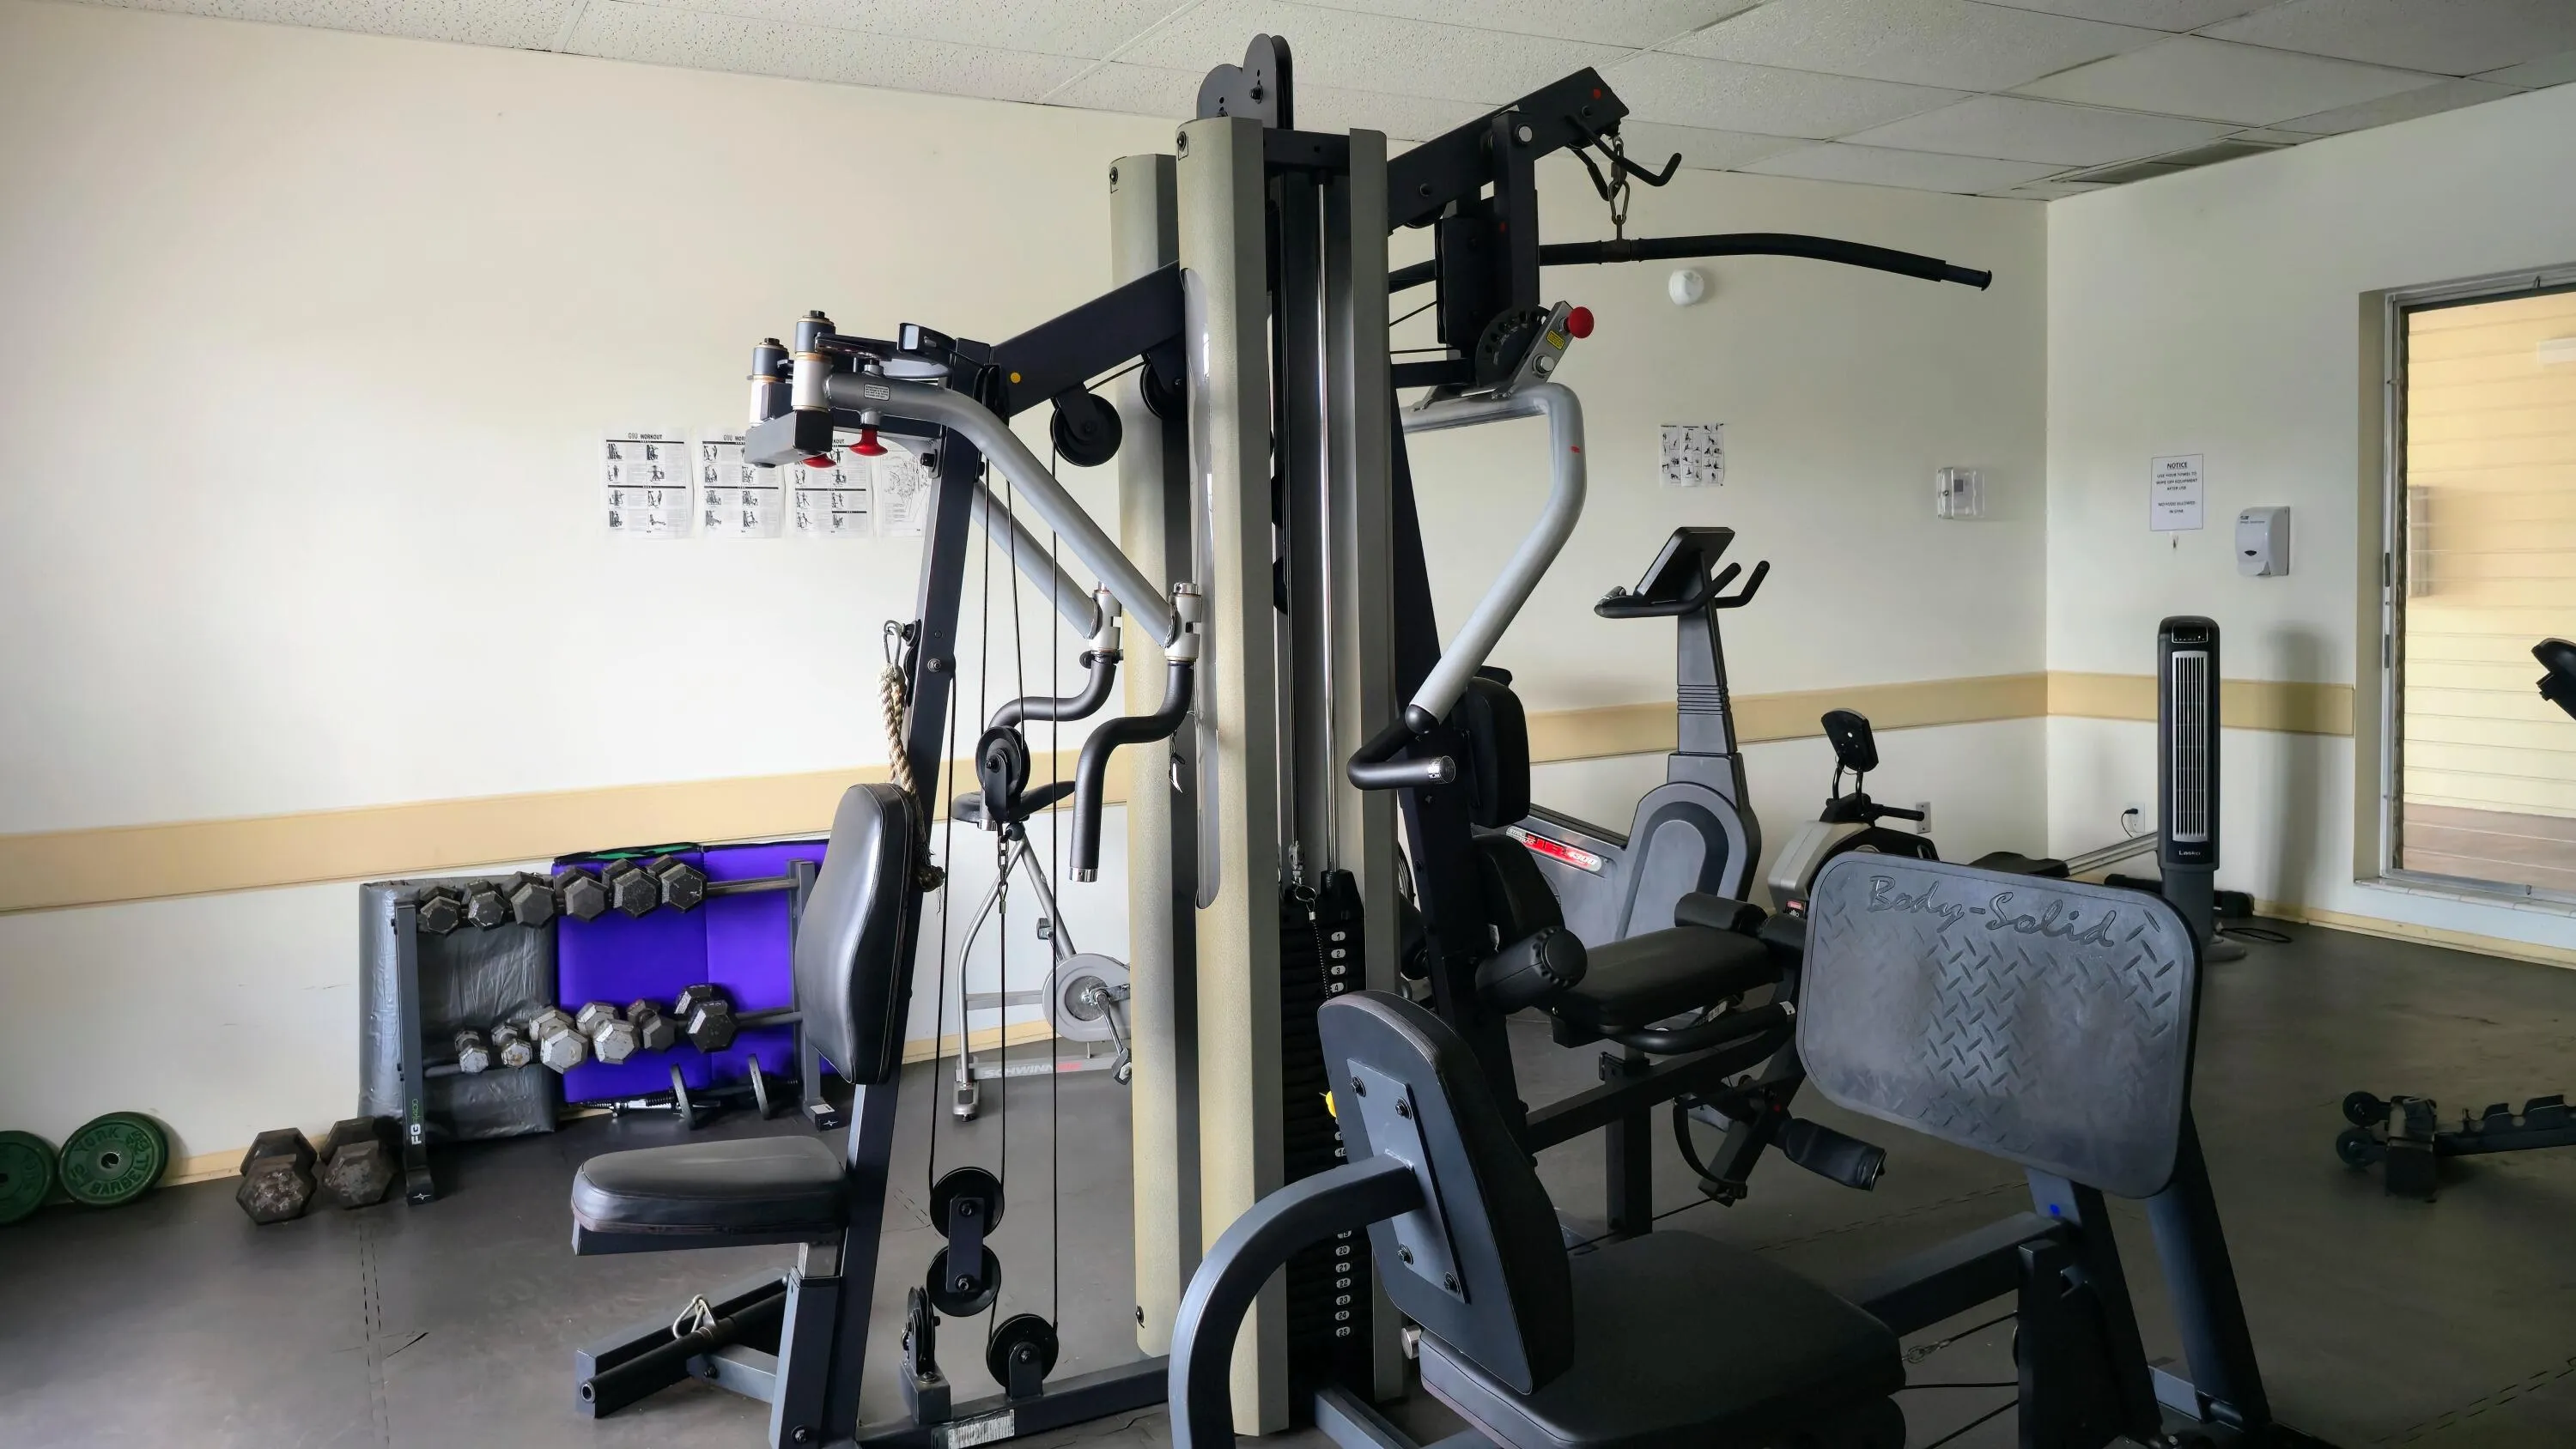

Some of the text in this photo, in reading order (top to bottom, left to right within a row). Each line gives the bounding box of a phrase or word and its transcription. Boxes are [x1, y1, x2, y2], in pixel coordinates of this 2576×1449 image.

[2166, 461, 2188, 470] NOTICE
[1866, 875, 2117, 948] Body-Solid
[73, 1126, 120, 1152] YORK
[88, 1155, 149, 1195] BARBELL
[1339, 1246, 1347, 1255] 20
[1339, 1264, 1347, 1272] 21
[1340, 1279, 1348, 1288] 22
[1339, 1296, 1348, 1305] 23
[1338, 1311, 1347, 1319] 24
[1339, 1328, 1347, 1337] 25
